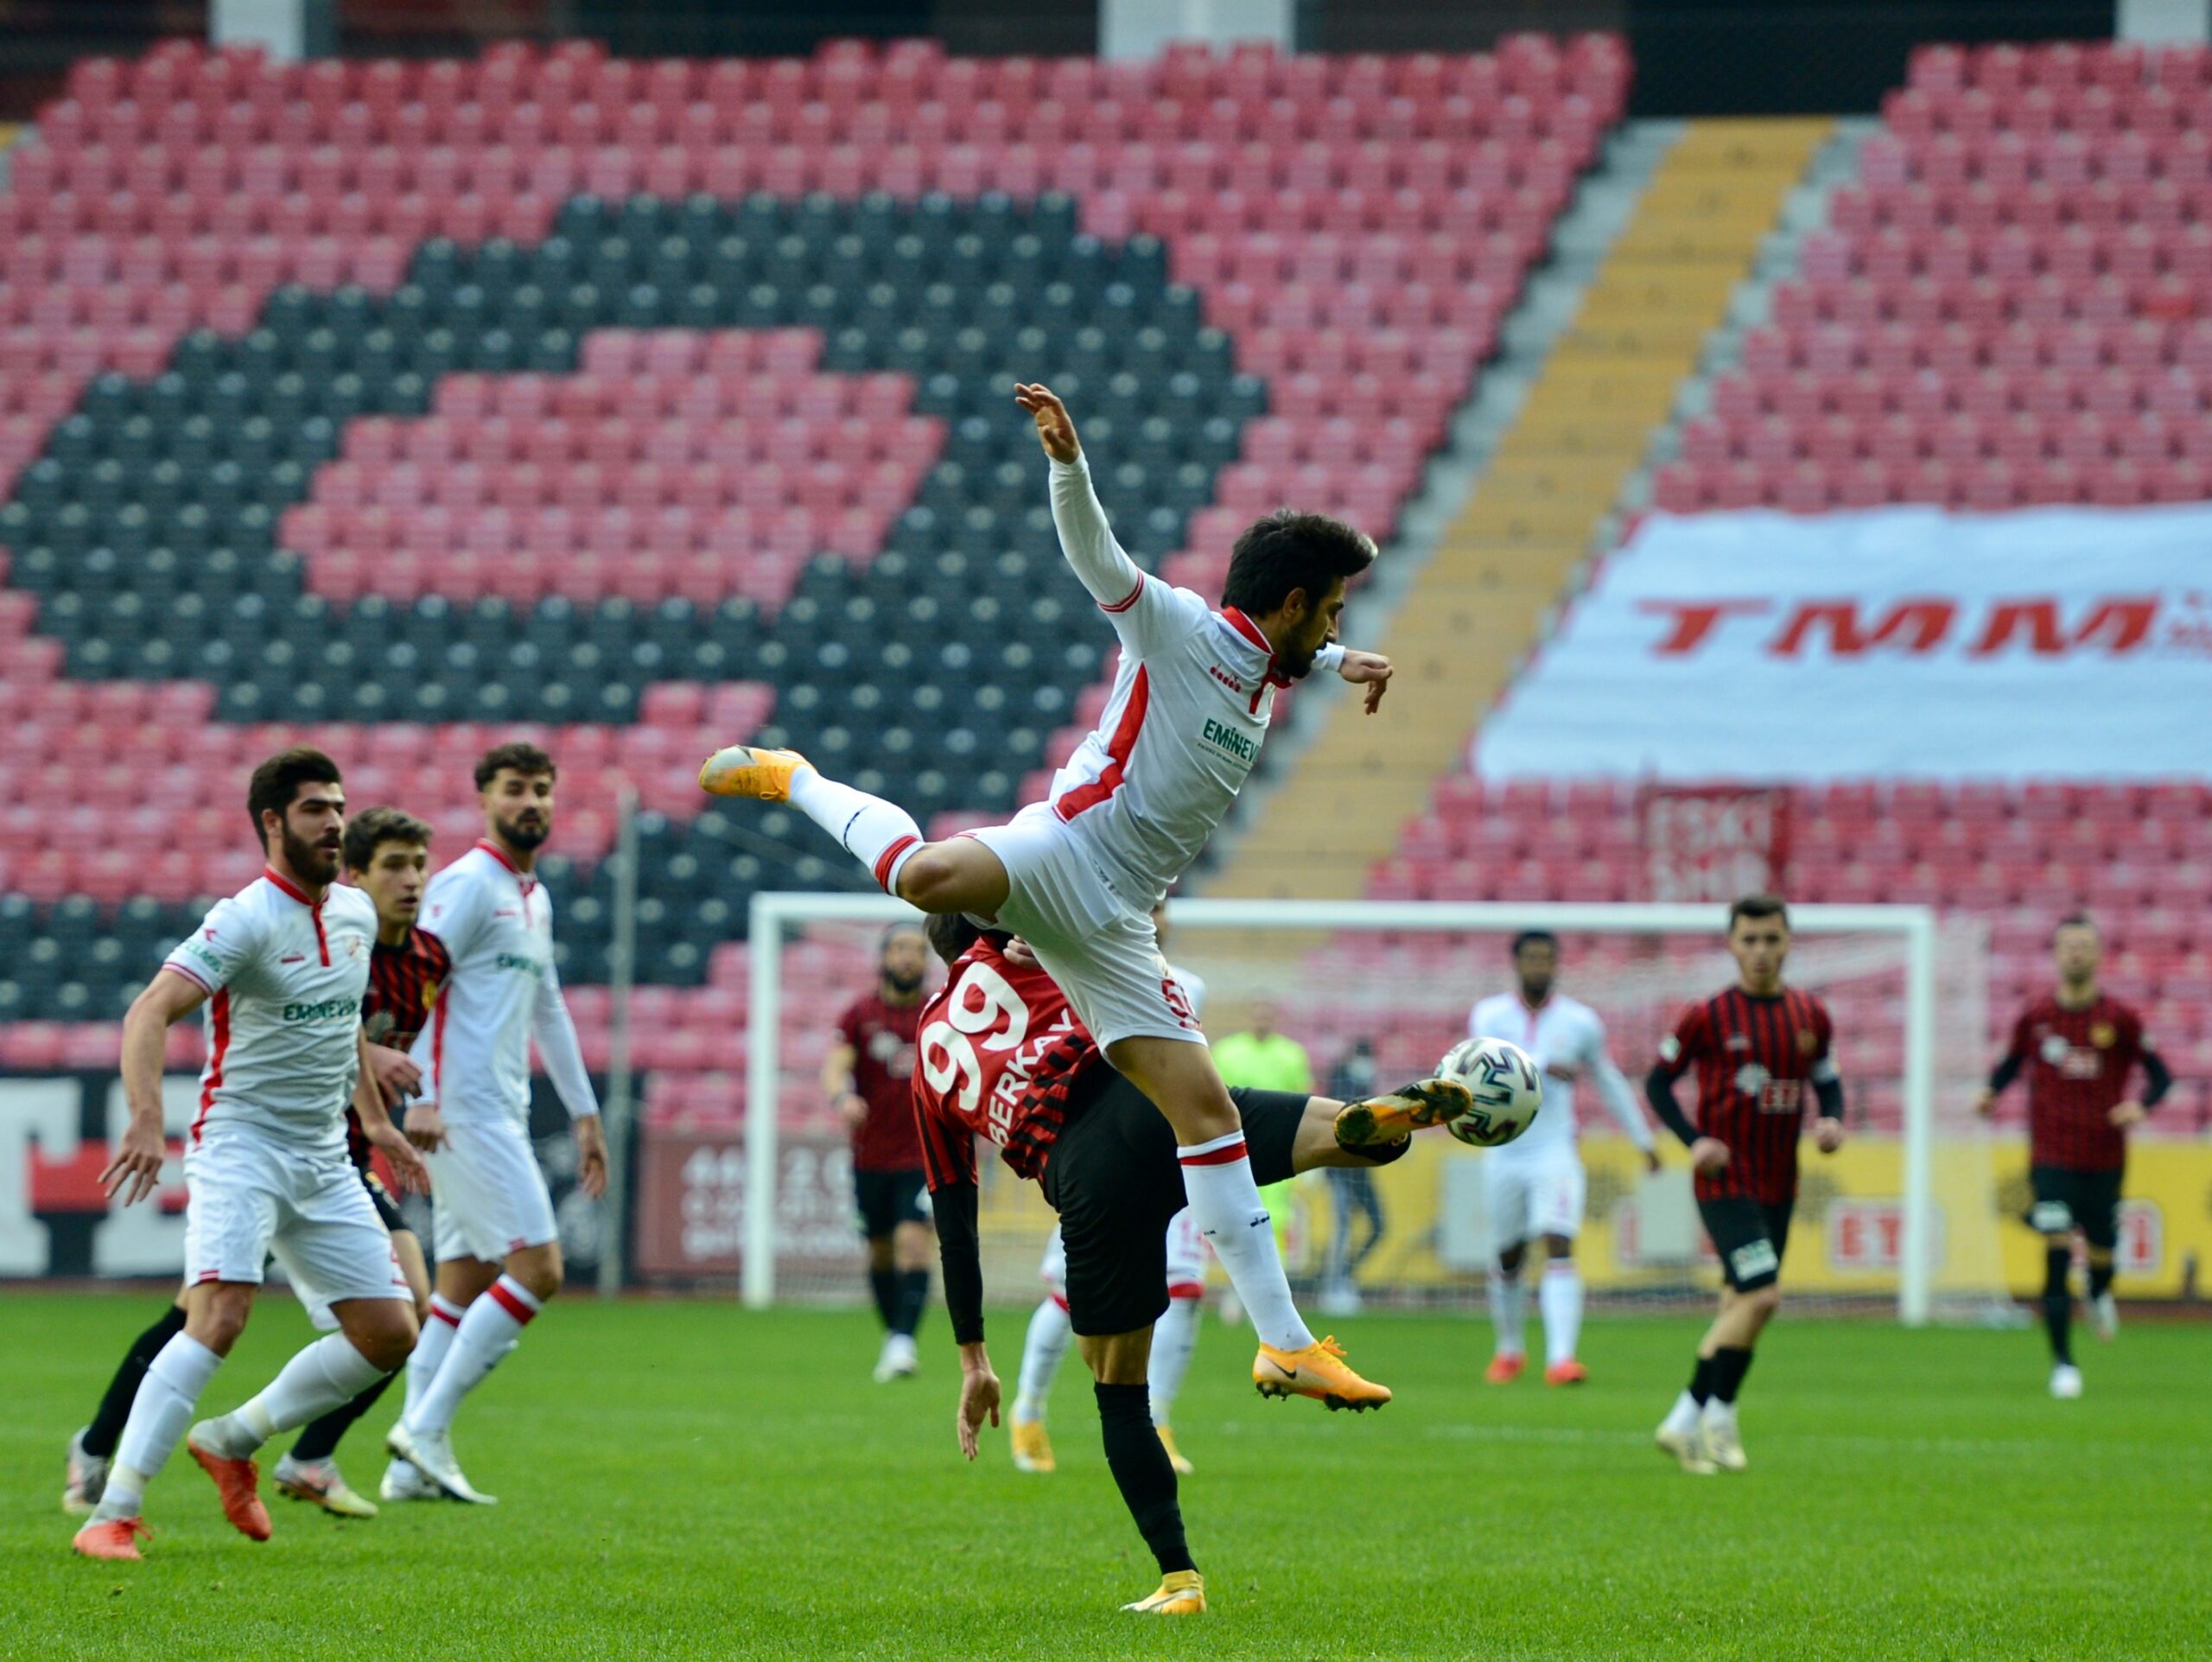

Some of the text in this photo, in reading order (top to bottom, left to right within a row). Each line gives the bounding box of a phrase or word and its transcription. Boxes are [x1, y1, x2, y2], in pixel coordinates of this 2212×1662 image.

[1635, 596, 2158, 659] TMM
[1203, 717, 1260, 762] EMİNEV
[920, 961, 1029, 1111] 99
[988, 1008, 1075, 1148] BERKAY
